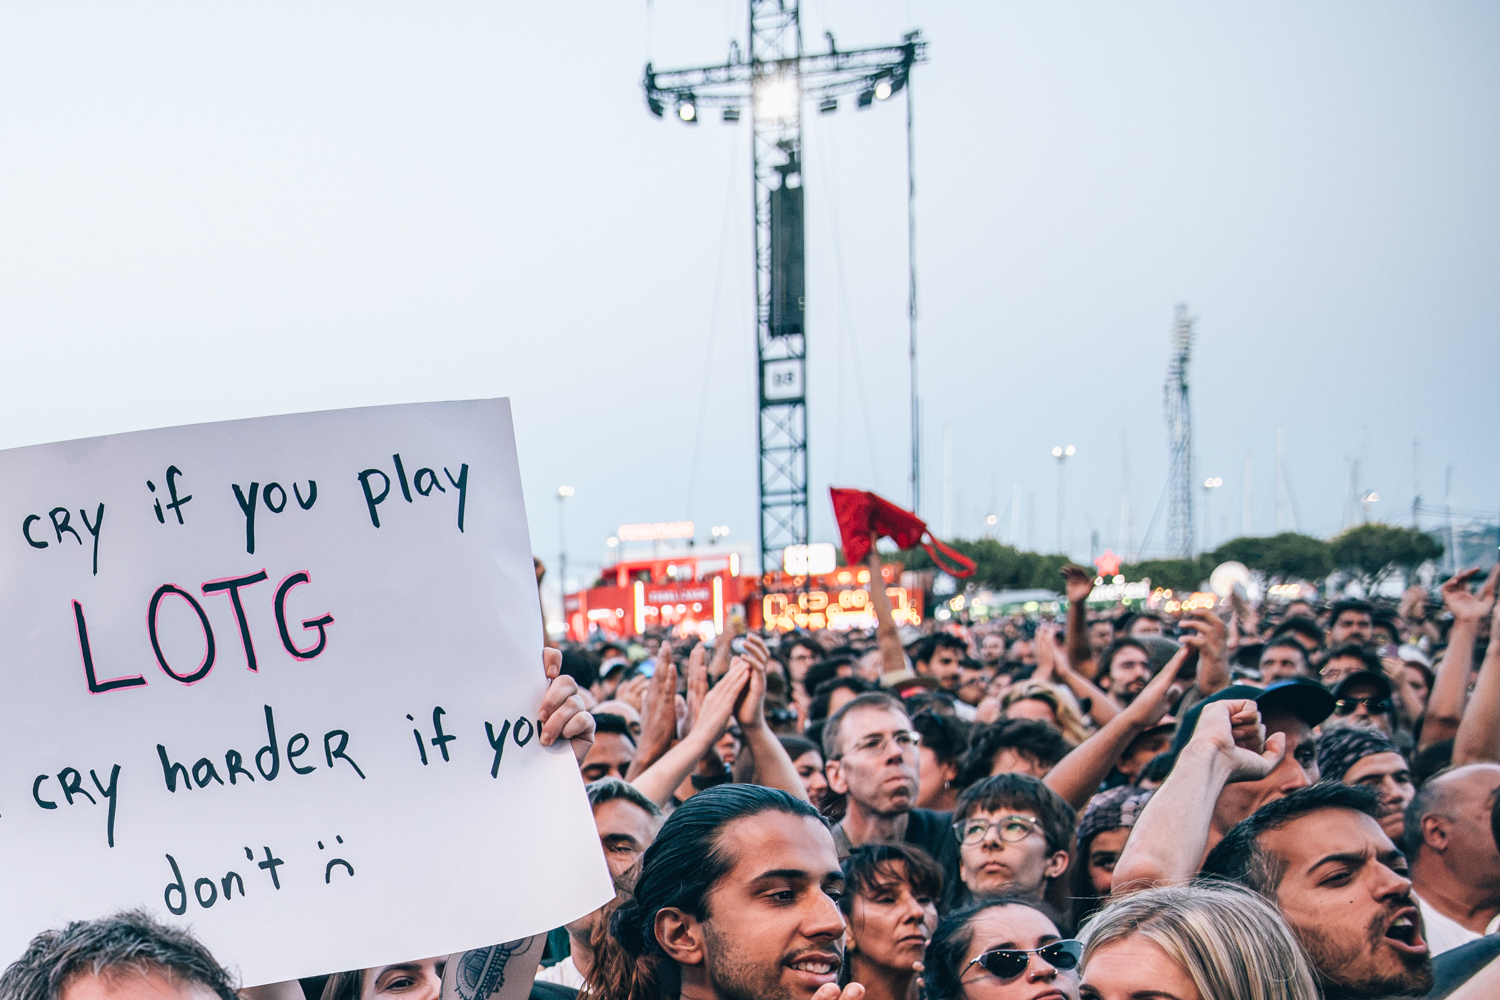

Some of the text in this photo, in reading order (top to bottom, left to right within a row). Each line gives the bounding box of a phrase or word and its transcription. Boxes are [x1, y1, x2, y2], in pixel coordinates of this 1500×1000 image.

[145, 464, 194, 526] if
[231, 478, 319, 555] you
[357, 453, 470, 534] play
[71, 568, 337, 697] LOTG
[405, 706, 457, 767] if
[164, 846, 286, 917] don't
